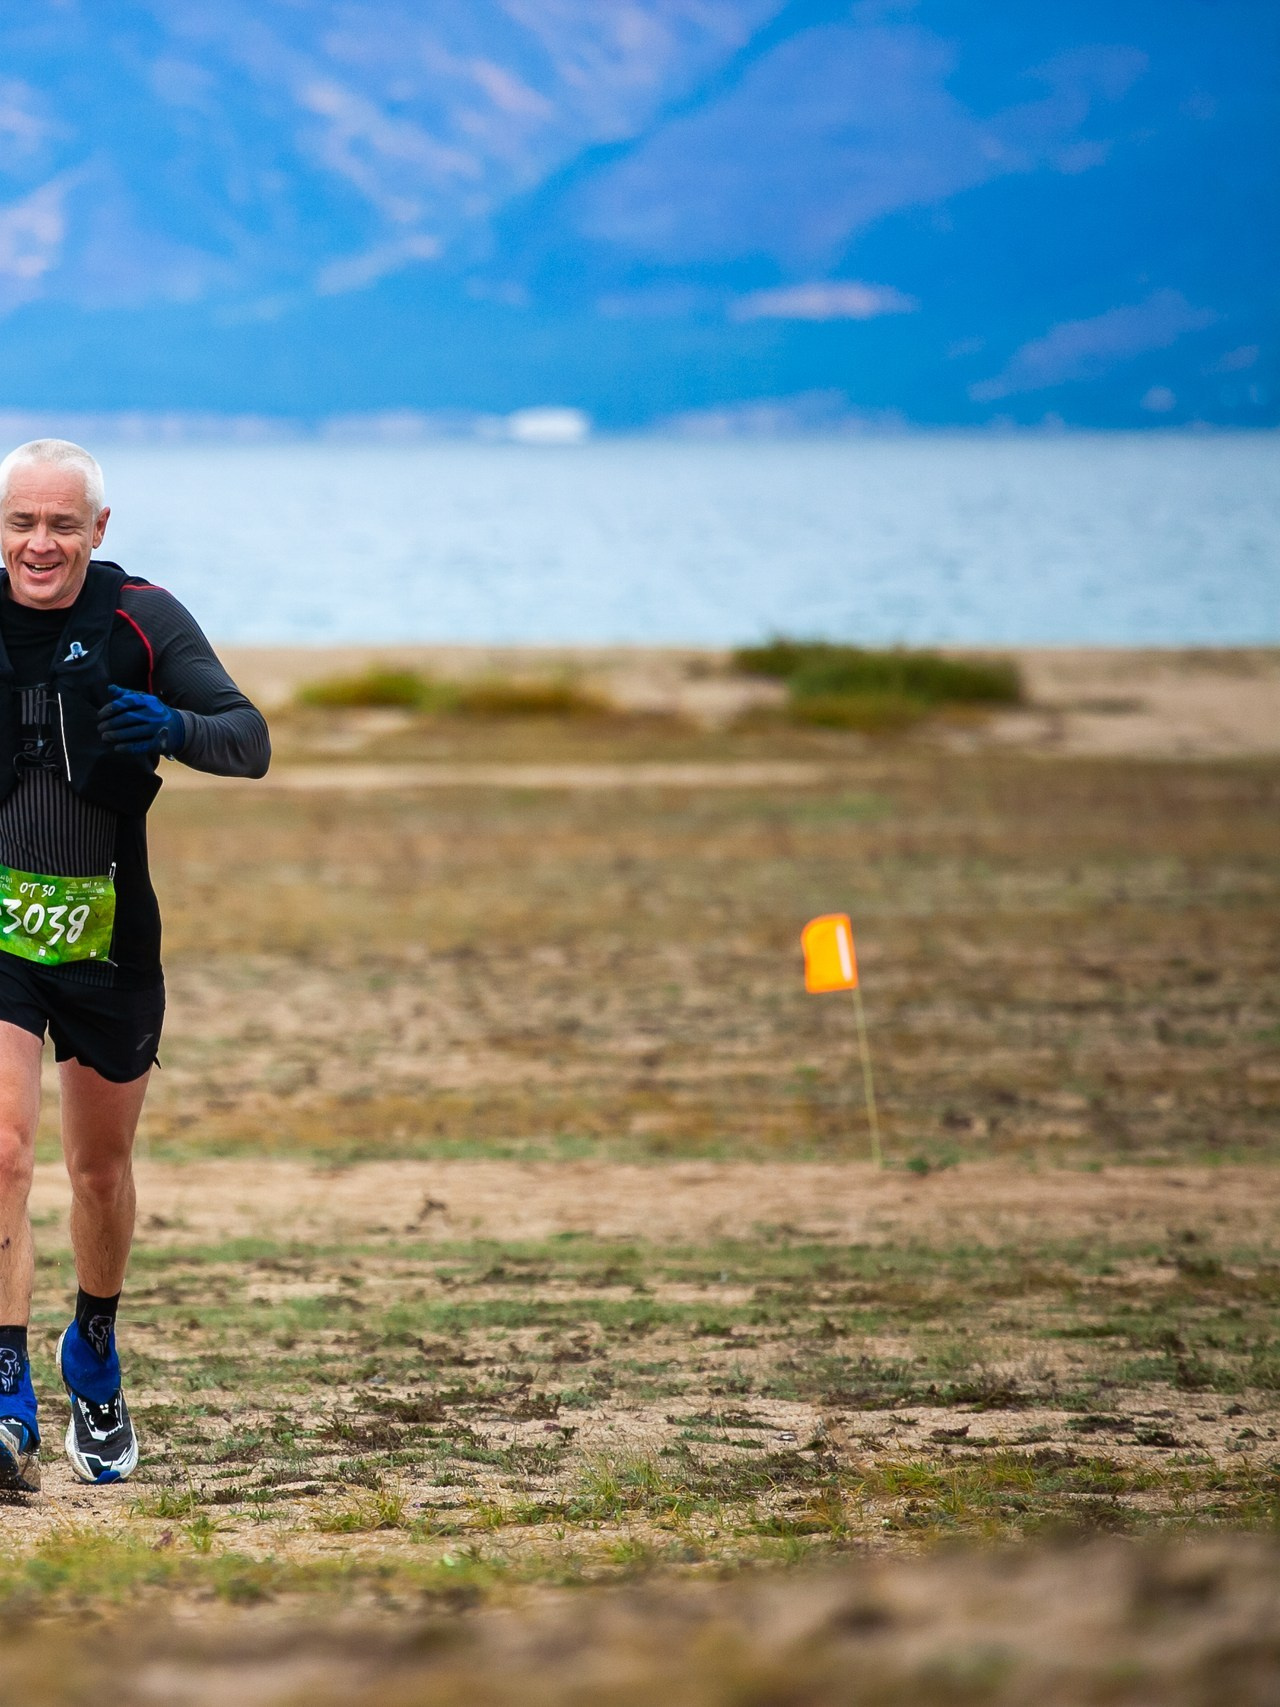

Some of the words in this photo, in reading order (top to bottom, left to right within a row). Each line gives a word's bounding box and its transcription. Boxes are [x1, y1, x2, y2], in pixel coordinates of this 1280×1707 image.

[20, 882, 40, 898] OT
[42, 885, 56, 897] 30
[3, 898, 90, 946] 3038
